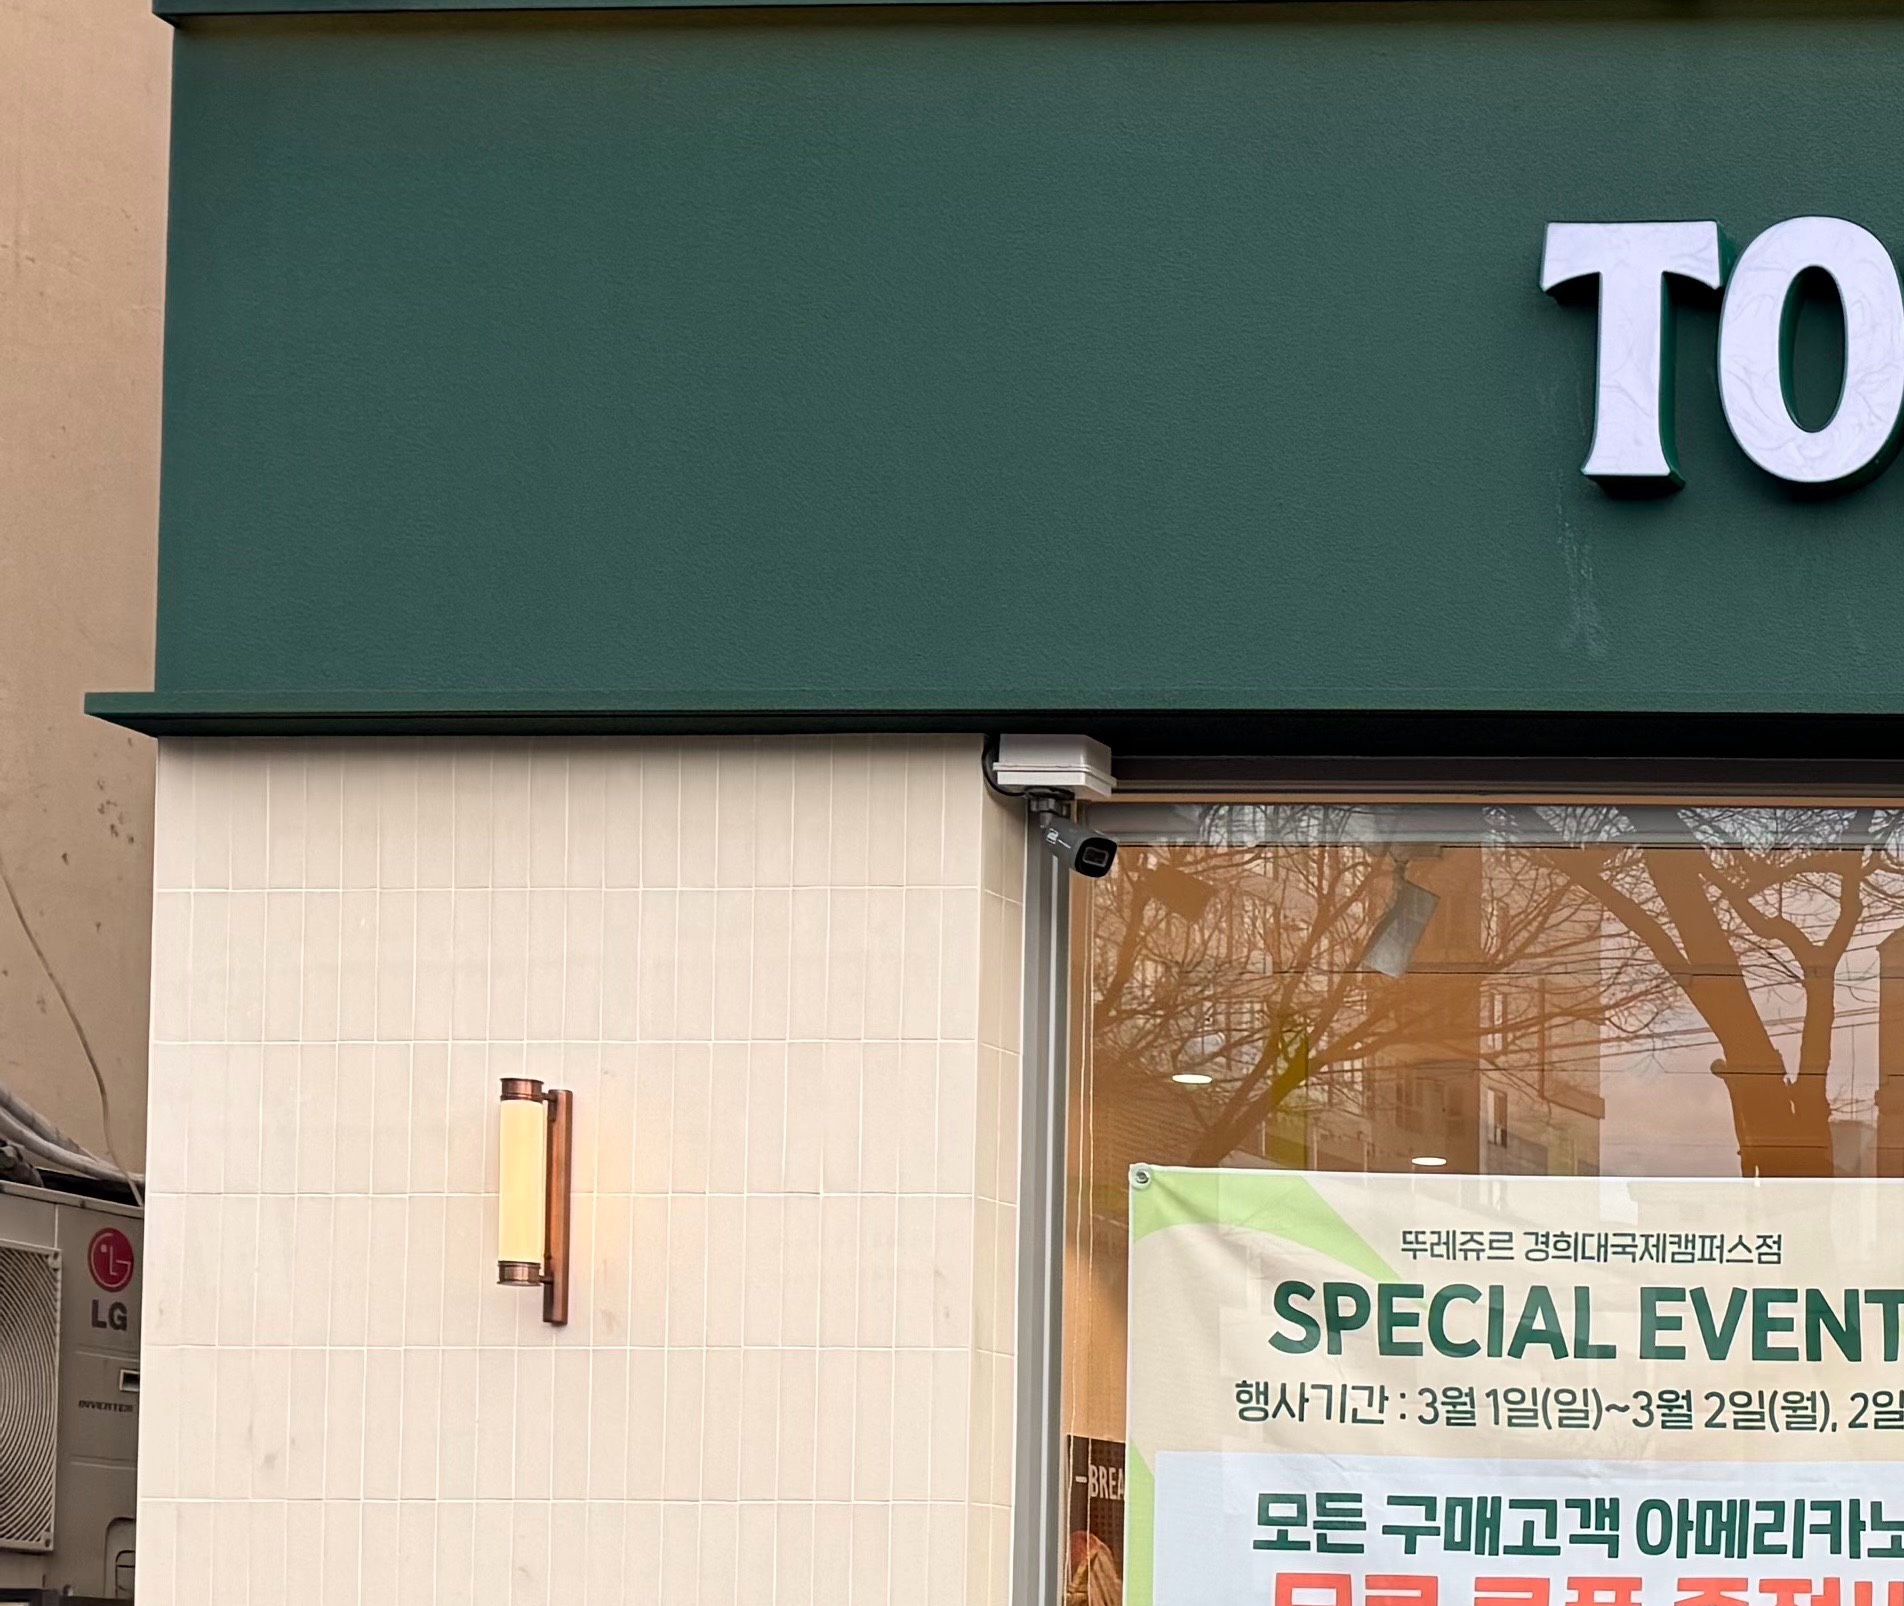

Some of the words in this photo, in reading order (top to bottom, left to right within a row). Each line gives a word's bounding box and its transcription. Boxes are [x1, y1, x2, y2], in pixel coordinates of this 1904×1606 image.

[1401, 1230, 1515, 1261] 뚜레쥬르
[1524, 1231, 1783, 1265] 경희대국제캠퍼스점
[91, 1299, 128, 1332] LG
[1267, 1280, 1617, 1360] SPECIAL
[1235, 1380, 1390, 1425] 행사기간
[1417, 1386, 1478, 1429] 3월
[1253, 1492, 1367, 1554] 모든
[1382, 1495, 1620, 1558] 구매고객
